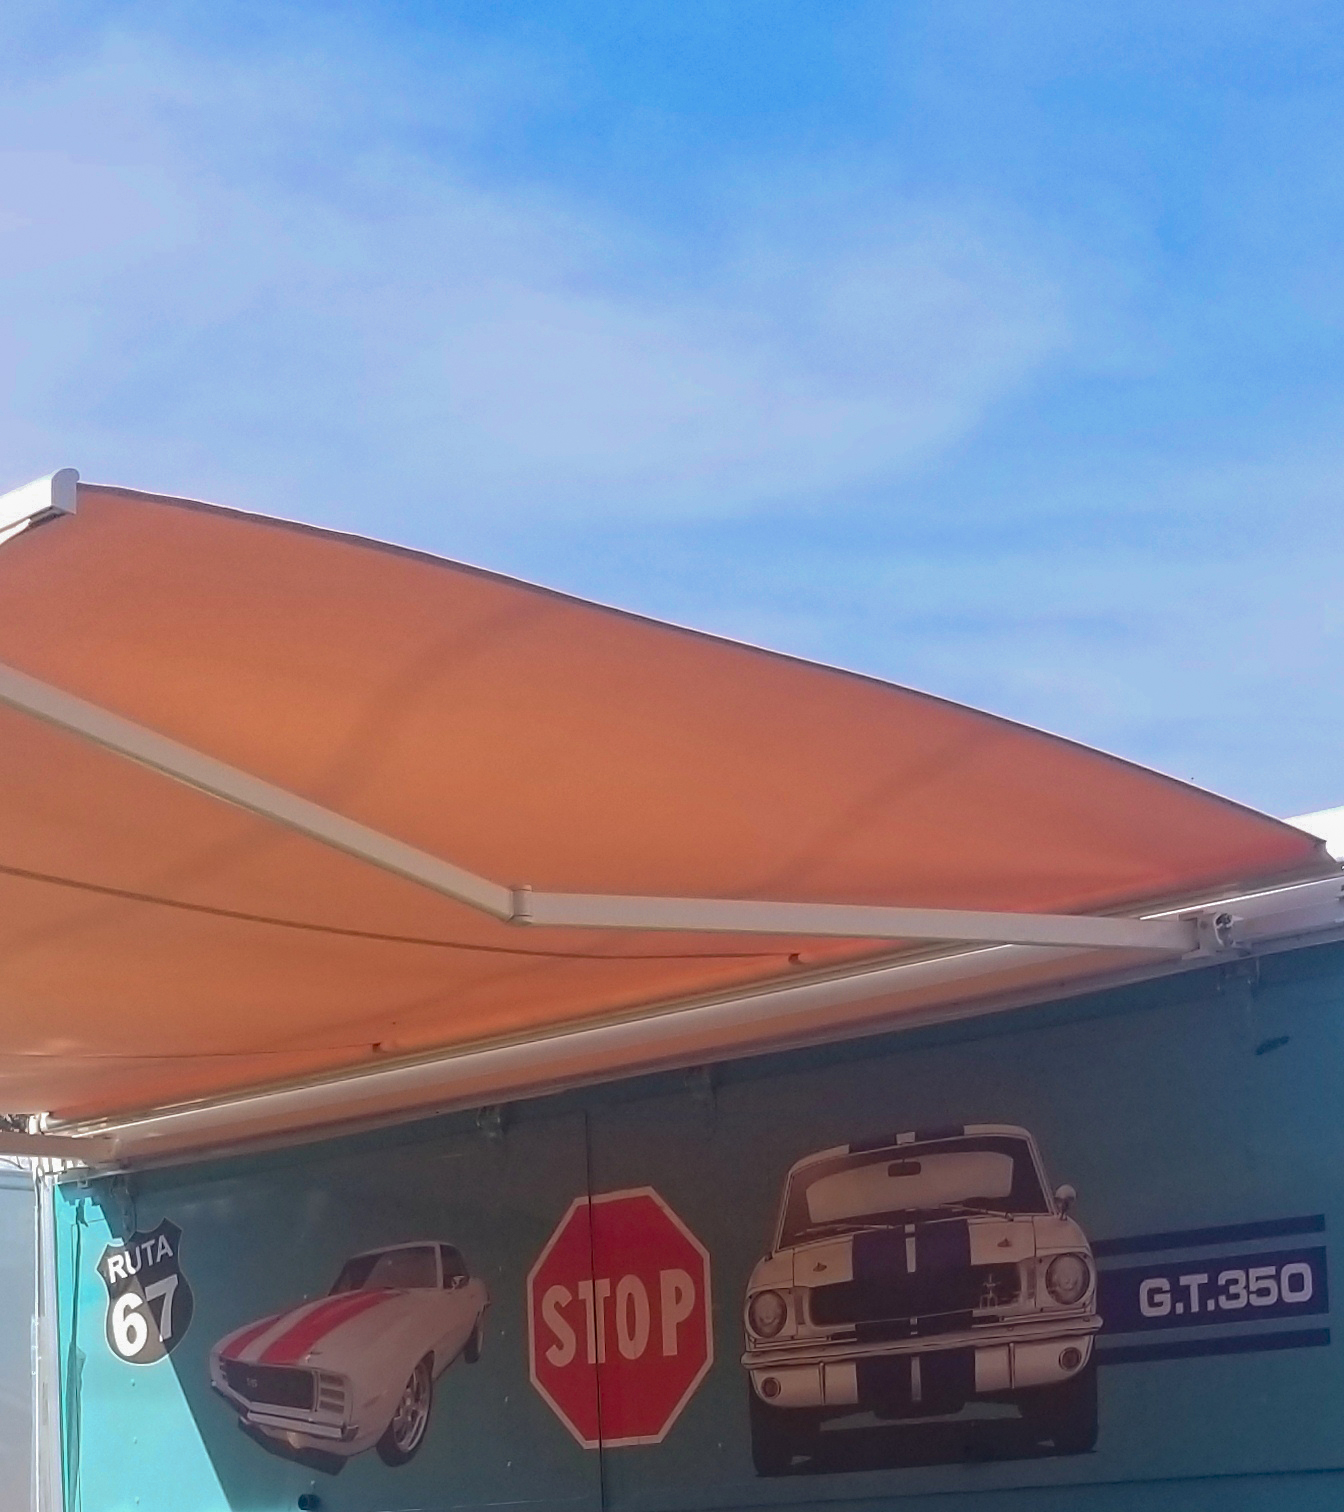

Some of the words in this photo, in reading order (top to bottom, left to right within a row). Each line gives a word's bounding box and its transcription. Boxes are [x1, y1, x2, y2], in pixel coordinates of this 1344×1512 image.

[107, 1234, 174, 1284] RUTA
[1139, 1262, 1314, 1318] G.T.350
[112, 1274, 179, 1357] 67
[542, 1267, 695, 1368] STOP
